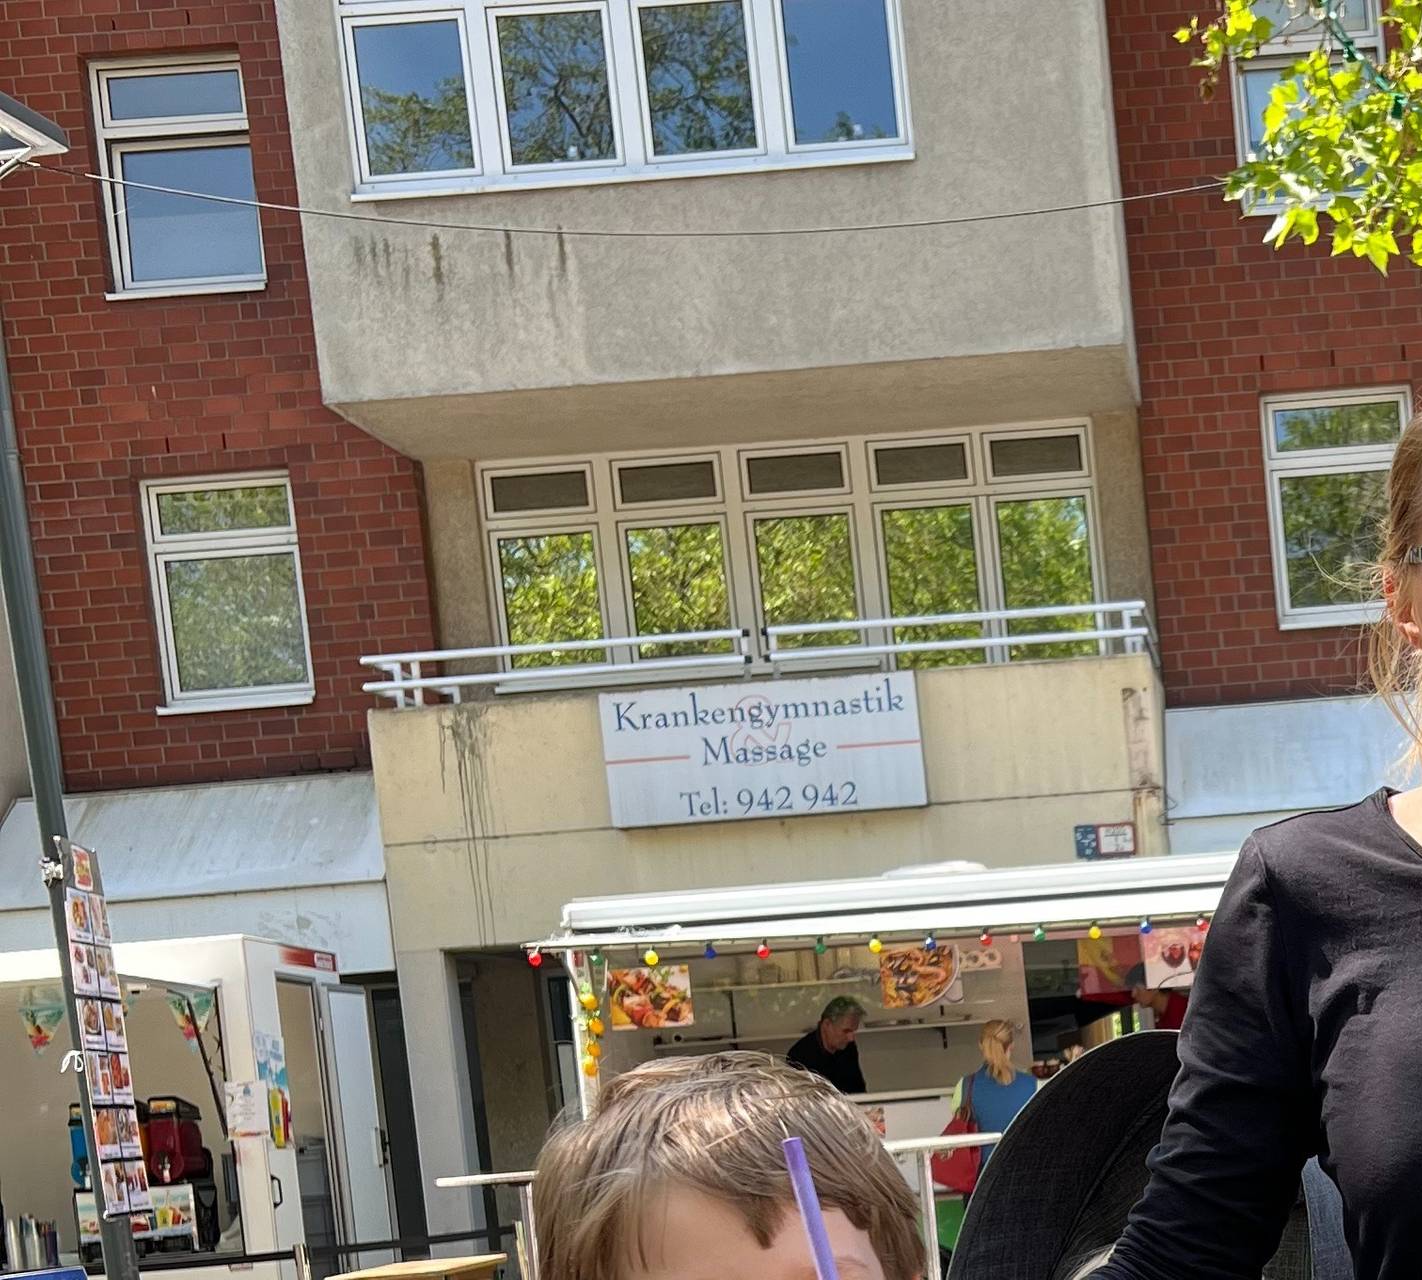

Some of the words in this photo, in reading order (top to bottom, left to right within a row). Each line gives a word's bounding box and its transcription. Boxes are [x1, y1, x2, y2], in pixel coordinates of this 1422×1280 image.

[612, 677, 905, 731] Krankengymnastik
[702, 736, 828, 767] Massage
[680, 786, 728, 817] Tel:
[736, 785, 794, 815] 942
[801, 780, 859, 810] 942
